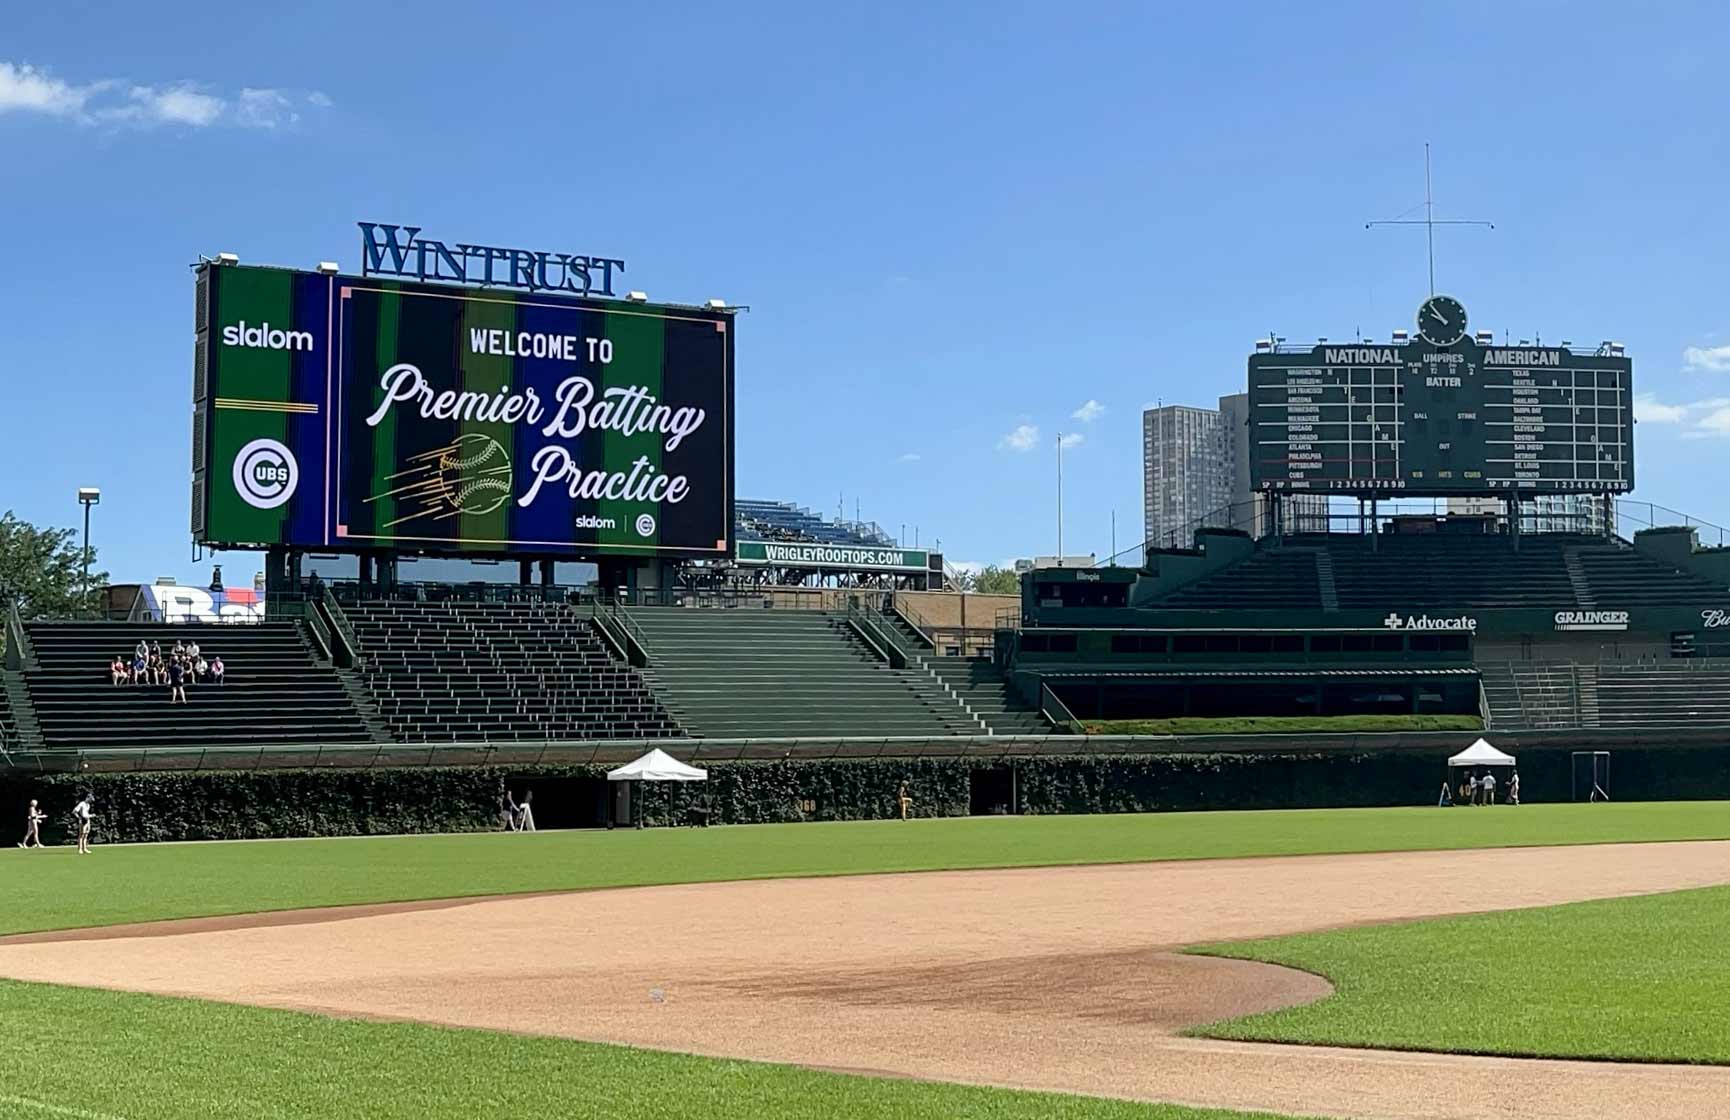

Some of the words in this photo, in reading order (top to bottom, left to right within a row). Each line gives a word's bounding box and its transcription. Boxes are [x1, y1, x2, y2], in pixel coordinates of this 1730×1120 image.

[358, 222, 624, 296] WINTRUST
[223, 321, 313, 351] slalom
[470, 328, 576, 360] WELCOME
[586, 338, 613, 363] TO
[1325, 349, 1402, 363] NATIONAL
[1423, 354, 1464, 363] UMPIRES
[1484, 350, 1560, 365] AMERICAN
[1426, 378, 1461, 387] BATTER
[366, 363, 545, 426] Premier
[543, 375, 705, 452] Batting
[518, 445, 690, 508] Practice
[576, 515, 615, 529] slalom
[766, 545, 903, 565] WRIGLEYROOFTOPS.COM
[1406, 614, 1477, 629] Advocate
[1555, 612, 1629, 623] GRAINGER
